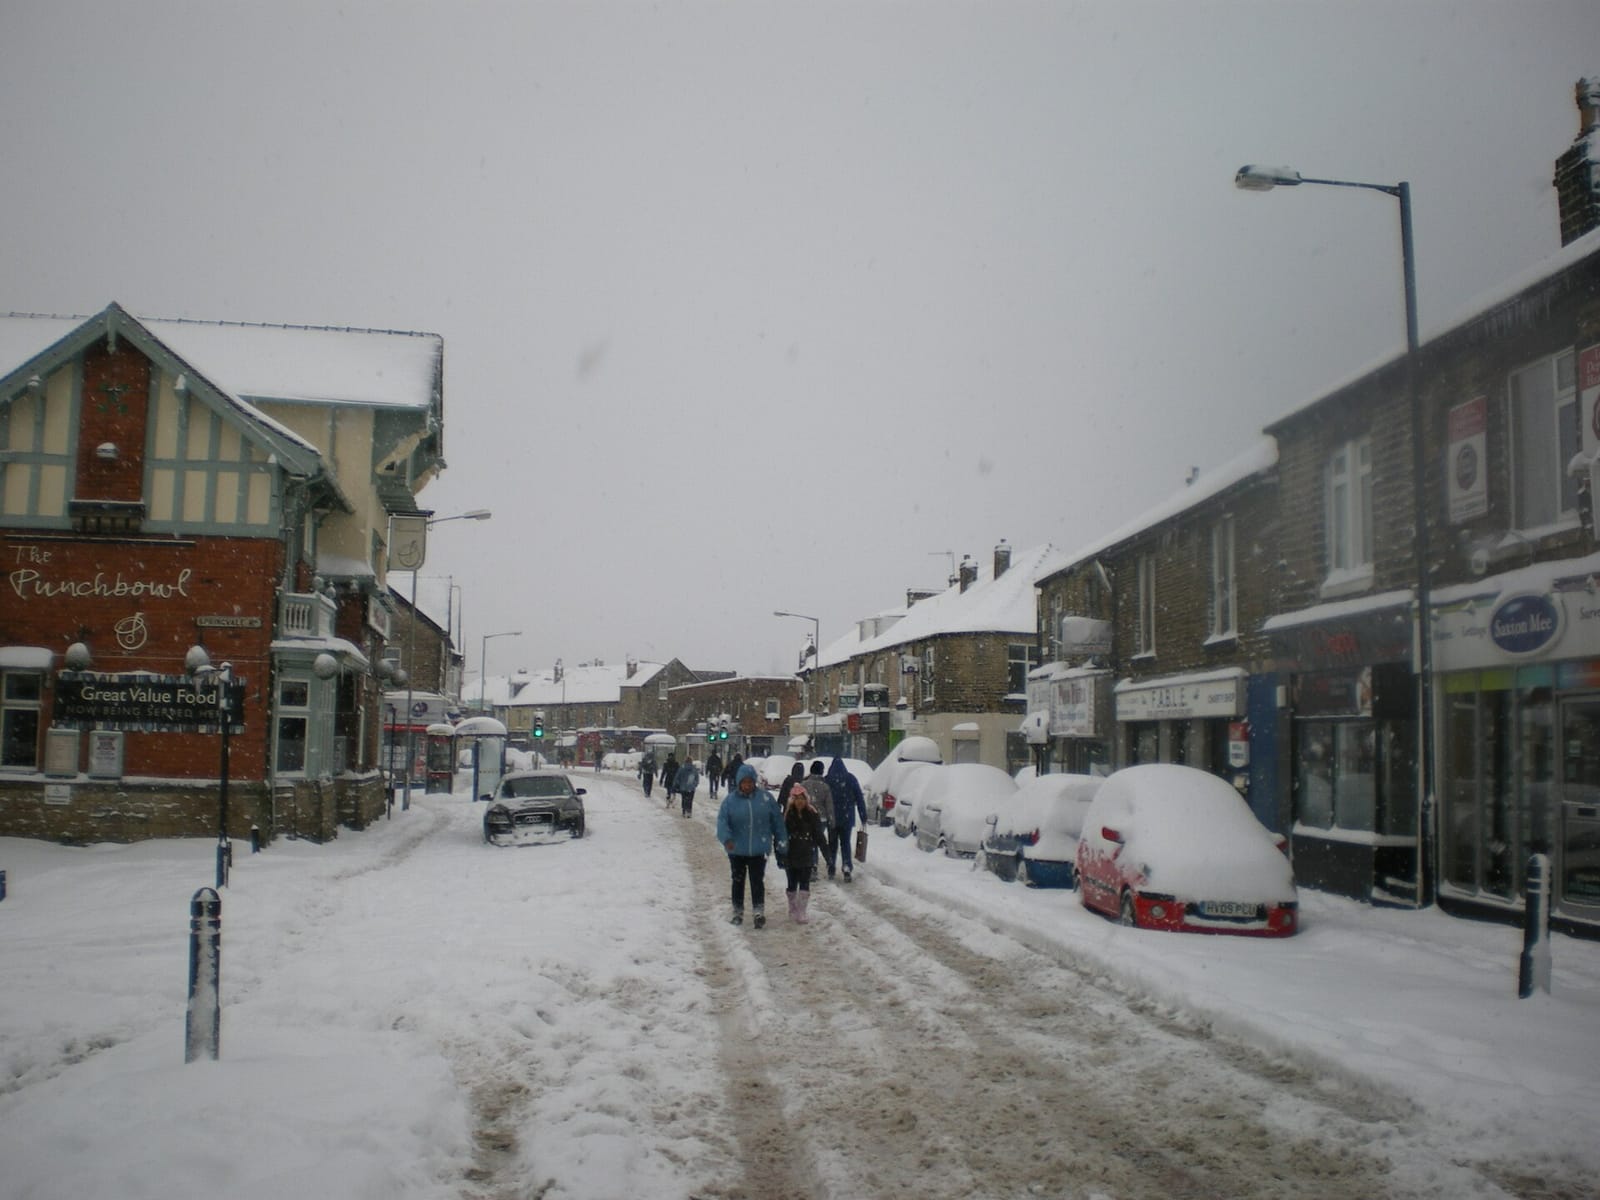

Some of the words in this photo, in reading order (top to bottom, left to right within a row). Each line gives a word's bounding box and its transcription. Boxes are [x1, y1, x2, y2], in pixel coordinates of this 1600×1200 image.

[8, 545, 52, 565] The
[9, 568, 192, 600] Punchbowl
[1495, 619, 1528, 639] Saxton
[1529, 612, 1552, 632] Mee
[81, 686, 126, 702] Great
[129, 687, 171, 704] Value
[176, 689, 217, 706] Food
[66, 704, 97, 716] NOW
[103, 706, 141, 718] BEING
[147, 707, 192, 719] SERVED
